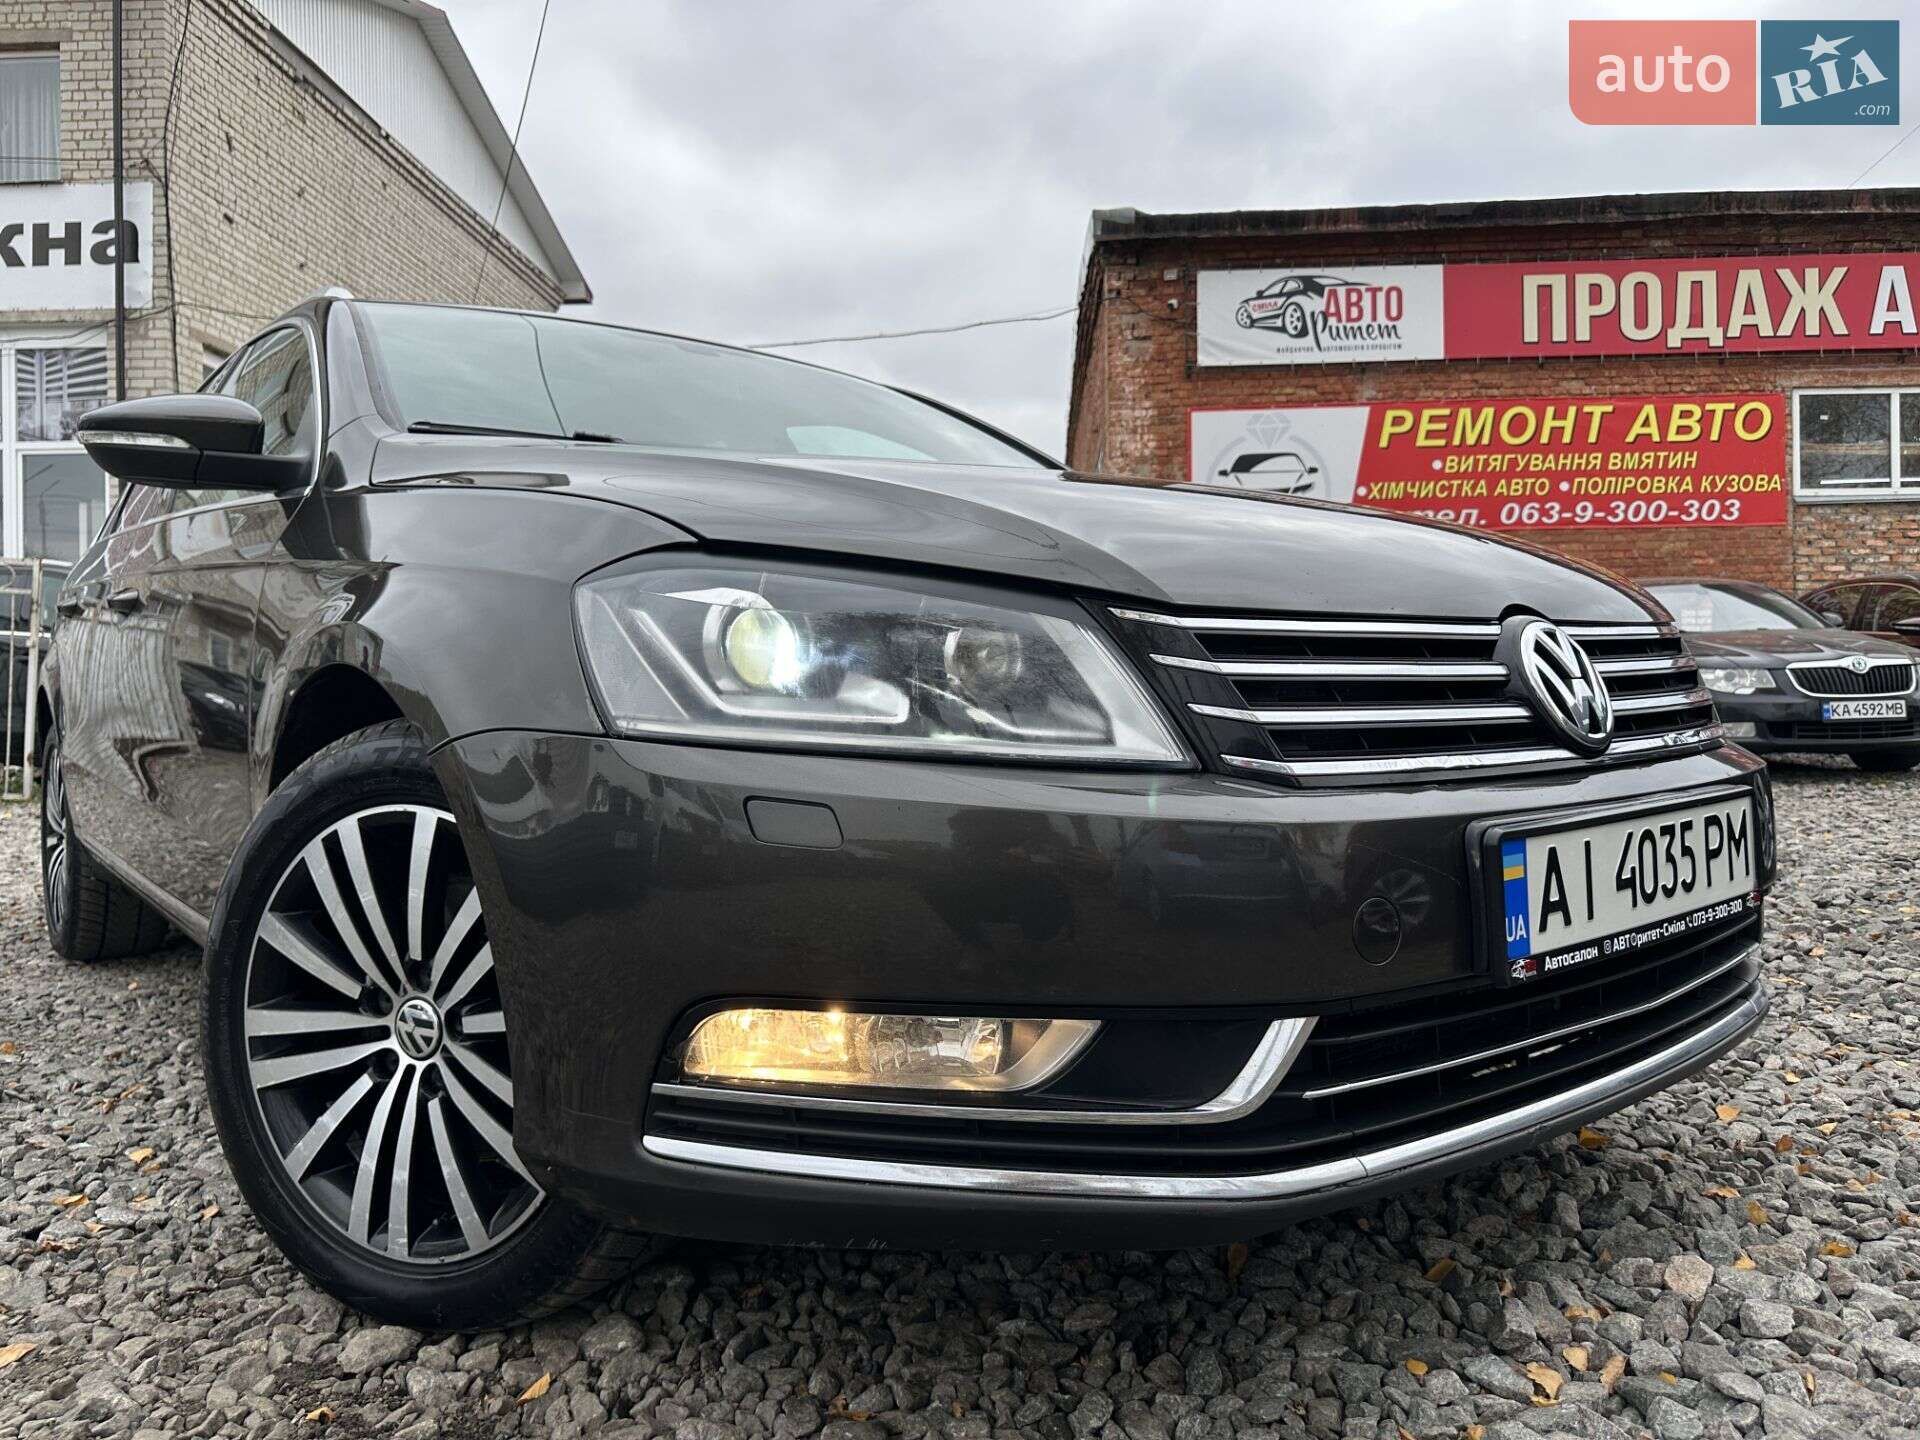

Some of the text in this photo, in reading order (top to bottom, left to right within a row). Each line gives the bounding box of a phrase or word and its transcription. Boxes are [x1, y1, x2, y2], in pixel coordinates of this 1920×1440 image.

[1324, 286, 1404, 324] АВТО
[1522, 265, 1919, 349] ПРОДАЖ А
[1378, 401, 1773, 449] РЕМОНТ АВТО
[1444, 451, 1698, 474] ВИТЯГУВАННЯ ВМЯТИН
[1368, 474, 1782, 500] ХІМЧИСТКА АВТО ПОЛІРОВКА КУЗОВА
[1500, 498, 1741, 526] 063-9-300-303
[1831, 703, 1851, 717] KA
[1854, 703, 1883, 716] 4592
[1886, 702, 1904, 715] MB
[1615, 818, 1697, 909] 4035
[1505, 914, 1527, 942] UA
[1544, 945, 1599, 972] Автосалон
[1692, 899, 1743, 926] 073-9-300-300
